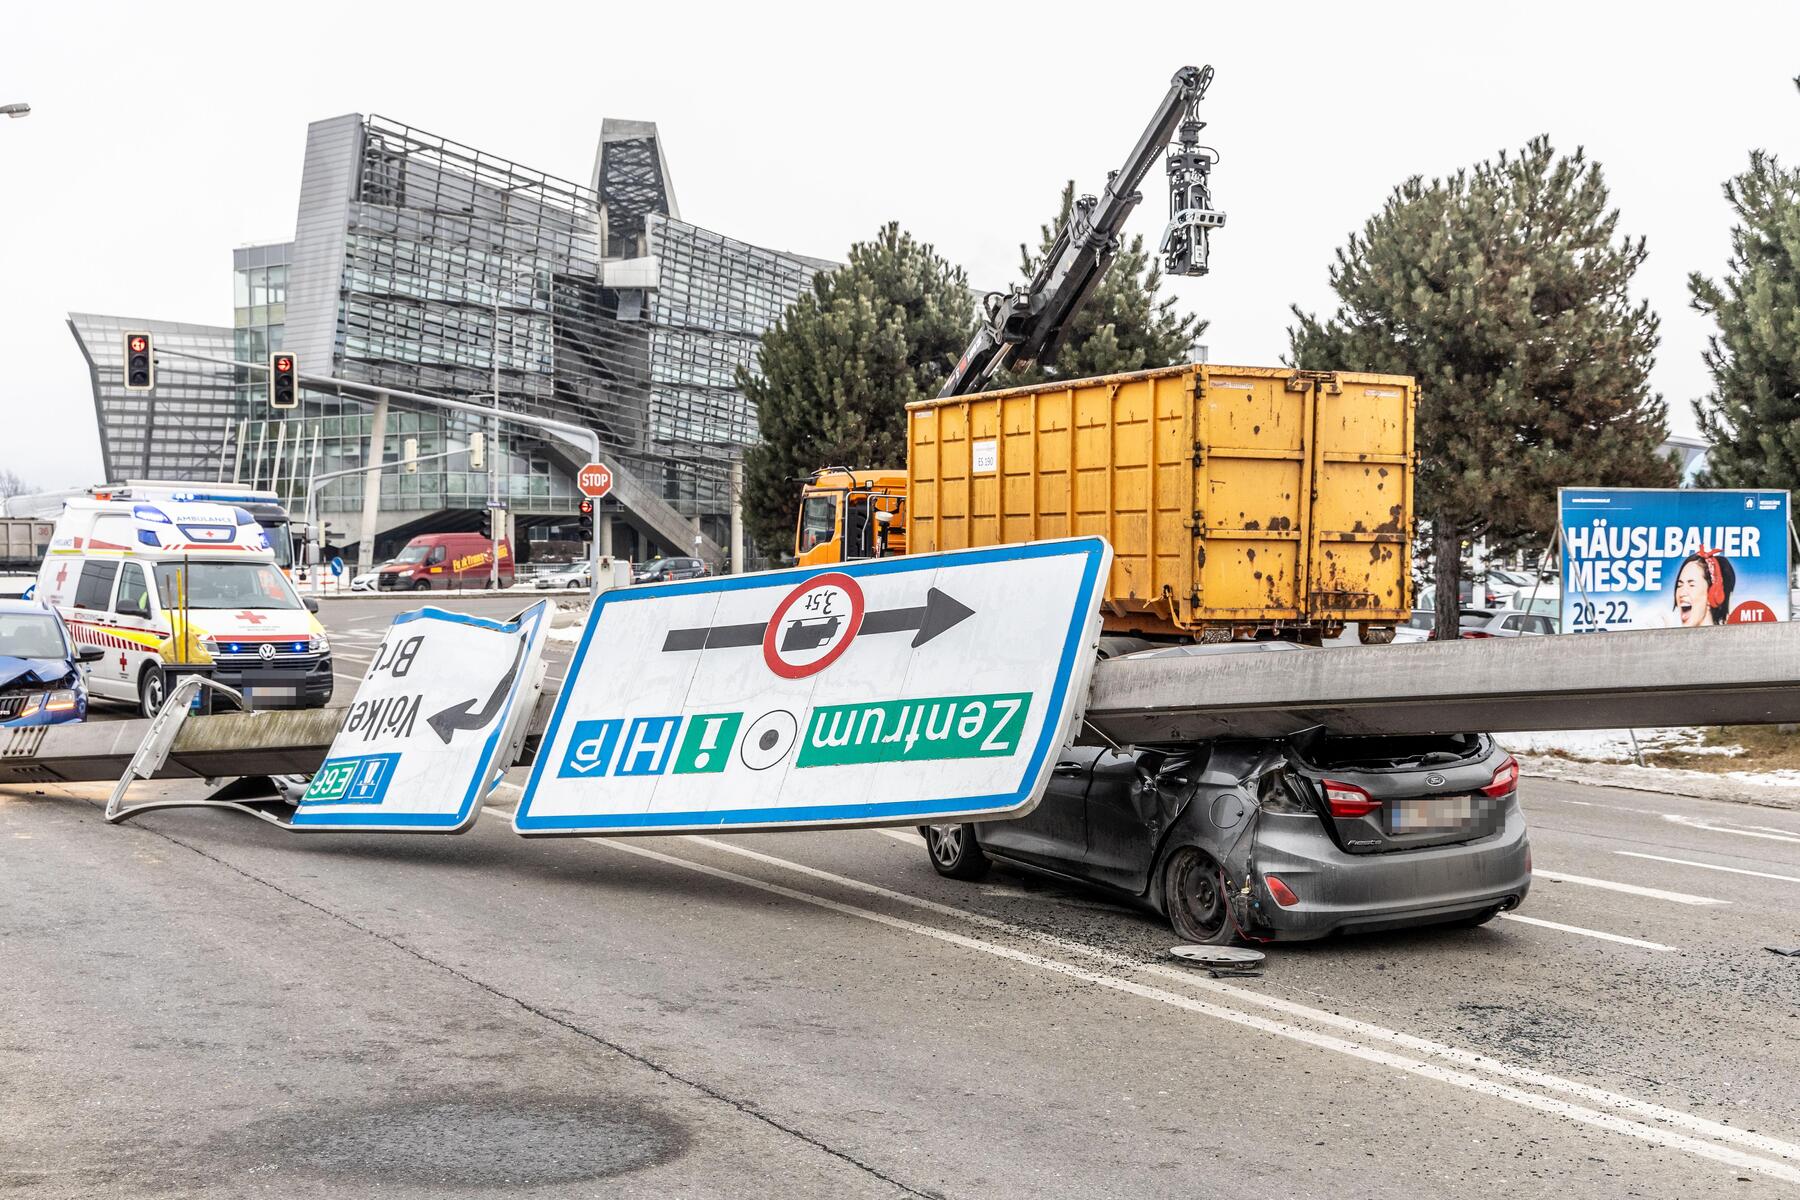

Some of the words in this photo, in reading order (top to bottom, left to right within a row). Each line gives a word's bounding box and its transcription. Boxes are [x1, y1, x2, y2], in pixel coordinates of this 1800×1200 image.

[582, 473, 608, 486] STOP
[1568, 518, 1761, 559] HÄUSLBAUER
[1568, 560, 1662, 593] MESSE
[804, 589, 837, 615] 3,5t
[1740, 609, 1764, 622] MIT
[812, 698, 1022, 754] Zentrum
[1347, 839, 1382, 847] Fiesta
